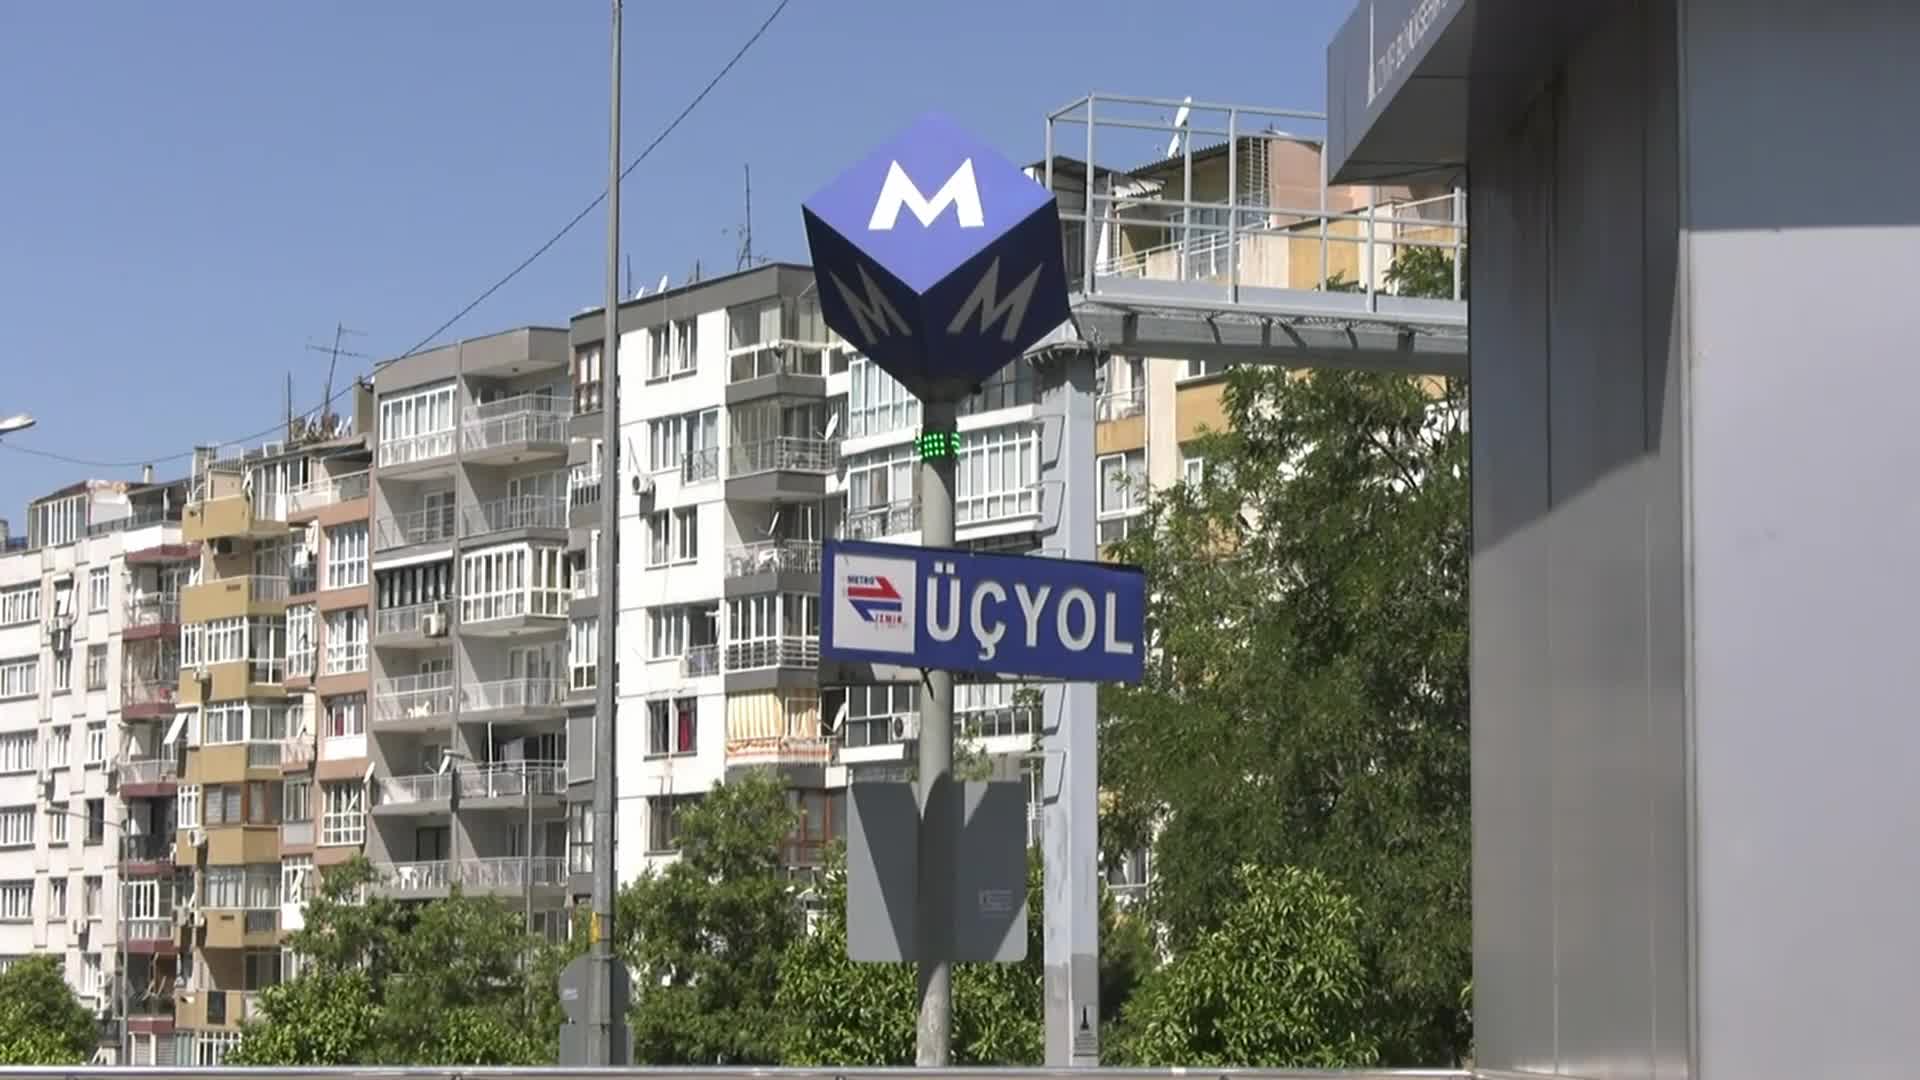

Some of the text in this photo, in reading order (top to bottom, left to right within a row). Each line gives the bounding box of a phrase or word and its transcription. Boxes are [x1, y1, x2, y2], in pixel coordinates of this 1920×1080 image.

[868, 158, 985, 230] M
[829, 263, 912, 345] M
[946, 256, 1043, 342] M
[847, 575, 875, 585] METRO
[926, 562, 1135, 661] ÜÇYOL
